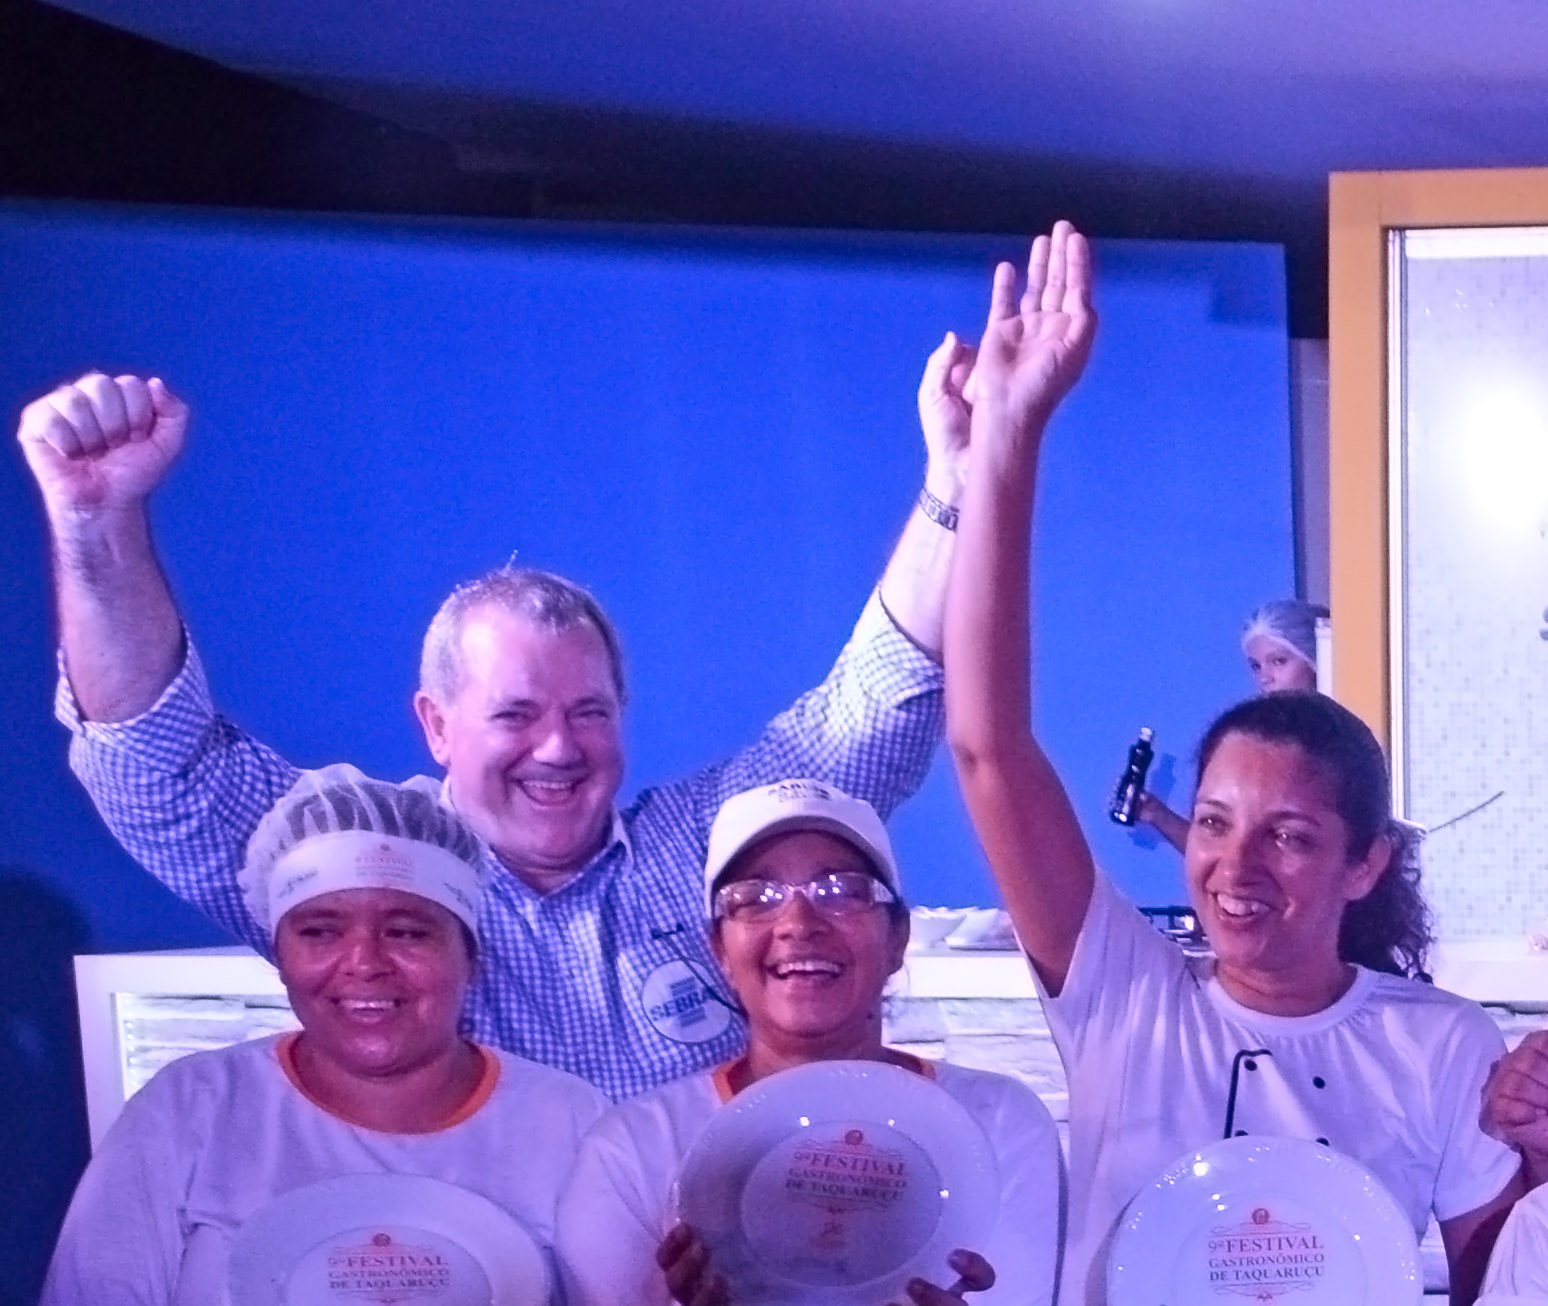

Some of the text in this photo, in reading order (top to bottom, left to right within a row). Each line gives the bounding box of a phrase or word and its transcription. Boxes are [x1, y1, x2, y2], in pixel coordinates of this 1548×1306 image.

[811, 1152, 905, 1176] FESTIVAL
[1225, 1235, 1324, 1253] FESTIVAL
[346, 1255, 450, 1268] FESTIVAL
[1208, 1252, 1325, 1268] GASTRONÔMICO
[1209, 1266, 1325, 1282] DE TAQUARUÇU
[329, 1280, 346, 1290] DE
